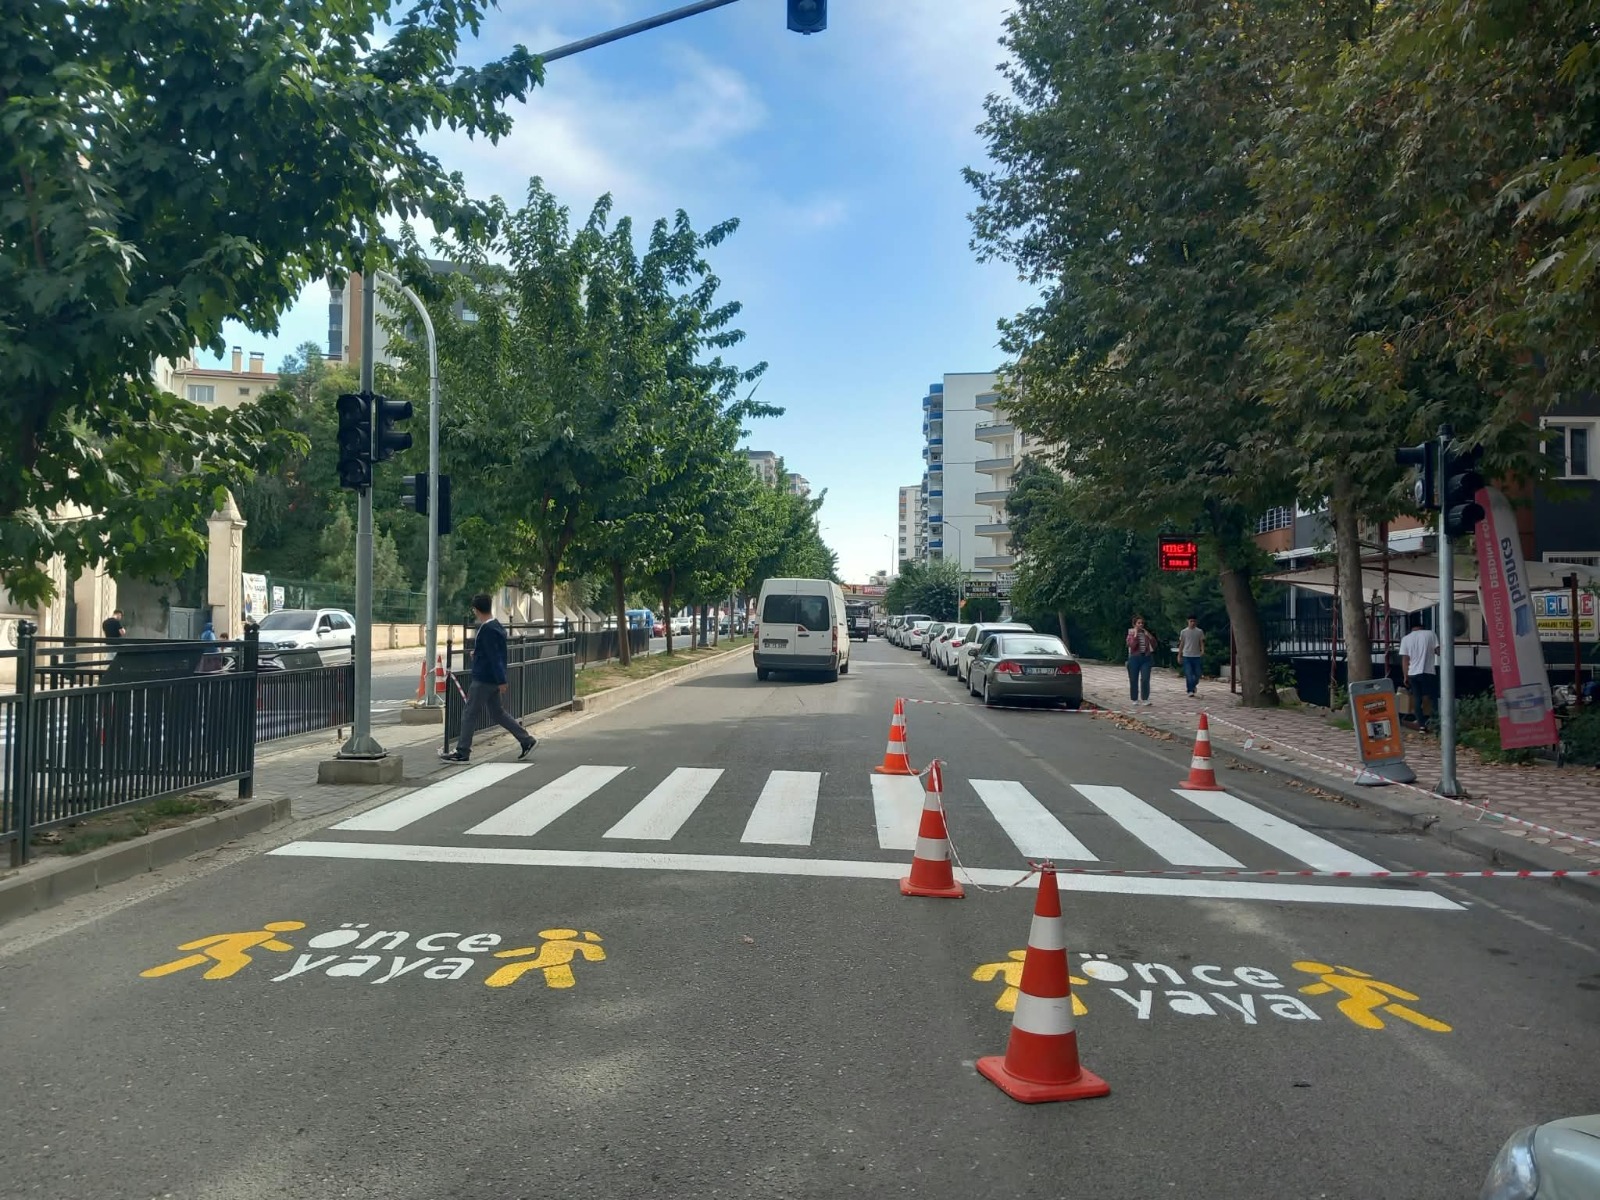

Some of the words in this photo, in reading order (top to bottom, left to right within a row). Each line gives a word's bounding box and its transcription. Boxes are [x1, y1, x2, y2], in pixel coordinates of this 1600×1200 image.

[1535, 594, 1593, 616] BELE
[308, 923, 502, 952] önce
[270, 954, 475, 984] yaya
[1079, 953, 1285, 989] önce
[1110, 988, 1322, 1024] yaya
